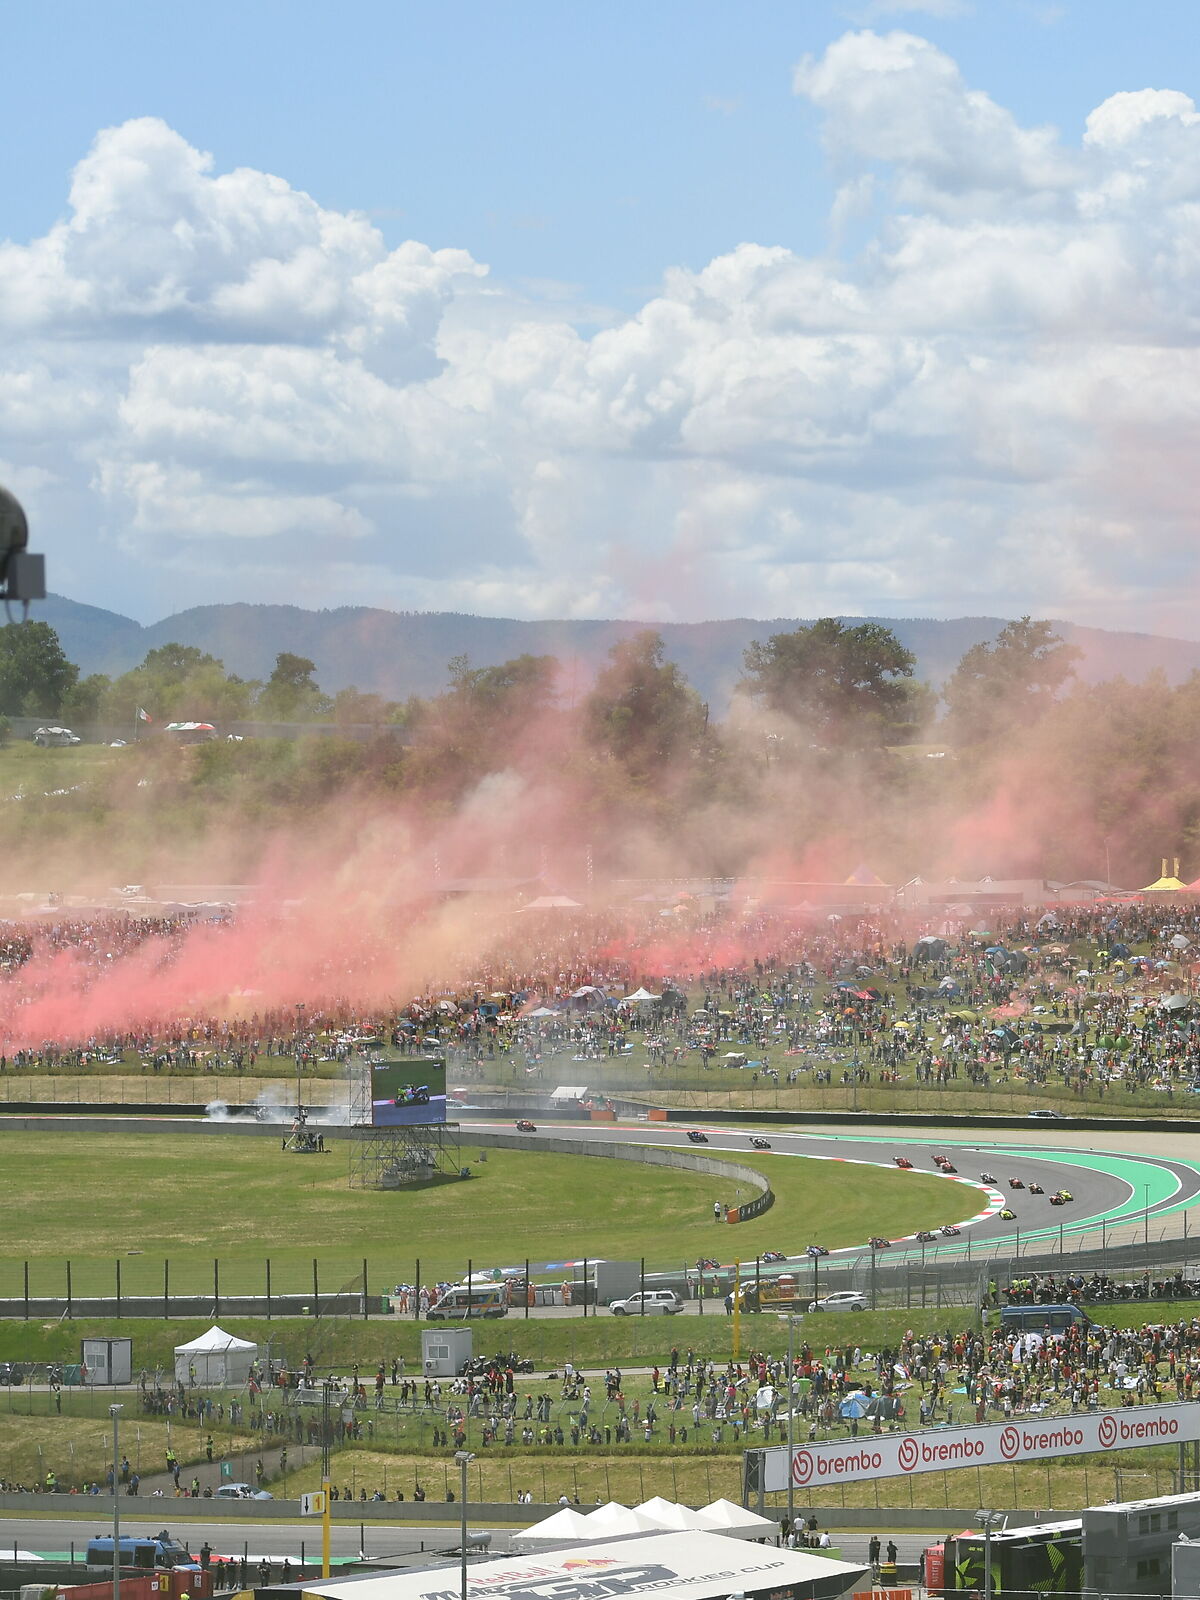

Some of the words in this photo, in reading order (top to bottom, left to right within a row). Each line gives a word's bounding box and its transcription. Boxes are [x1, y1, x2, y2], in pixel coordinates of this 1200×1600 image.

[1023, 1427, 1083, 1451] brembo
[1121, 1416, 1178, 1440] brembo
[922, 1437, 984, 1462] brembo
[223, 1464, 230, 1475] 1
[817, 1450, 882, 1475] brembo
[637, 1570, 736, 1591] ROOKIES
[740, 1561, 785, 1573] CUP
